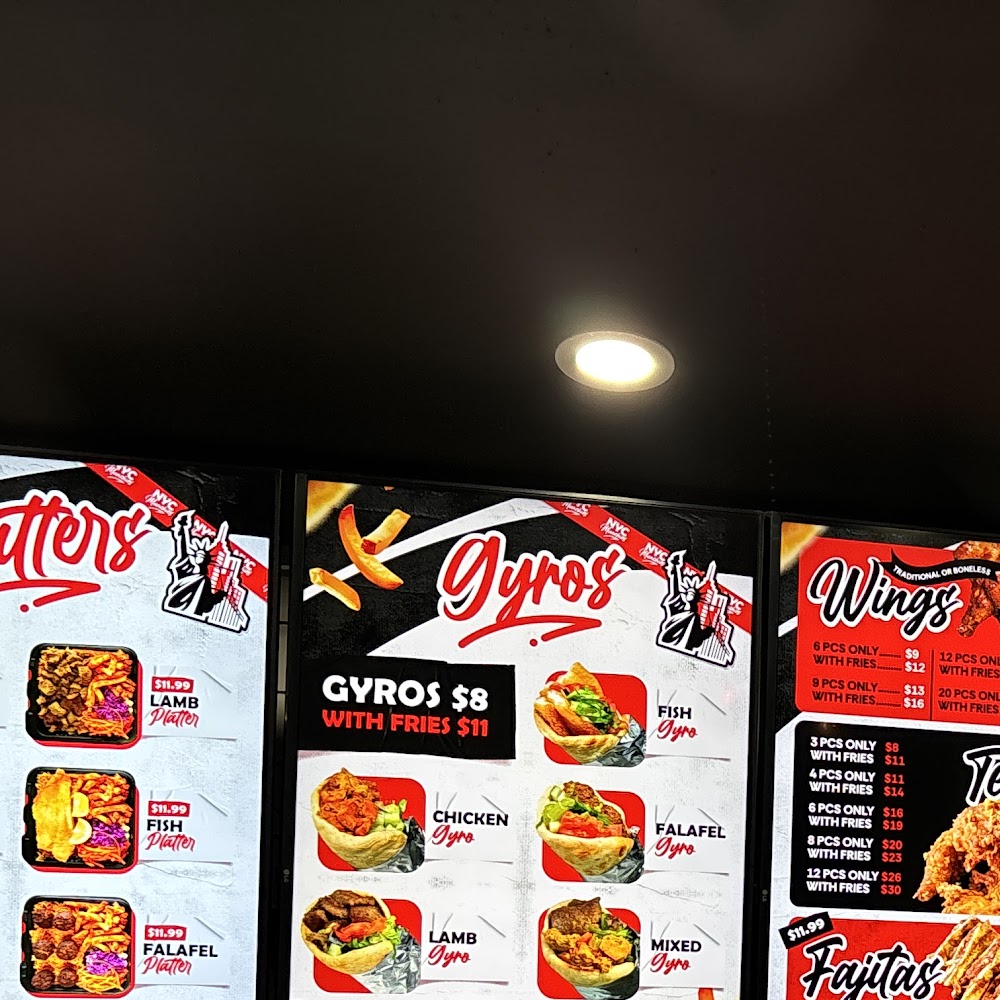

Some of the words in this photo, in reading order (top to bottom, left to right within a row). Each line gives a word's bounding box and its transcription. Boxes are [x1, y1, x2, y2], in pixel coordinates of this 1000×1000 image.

[893, 565, 942, 582] TRADITIONAL
[942, 568, 952, 577] OR
[953, 564, 992, 576] BONELESS
[809, 559, 960, 639] Wings
[813, 641, 820, 651] 6
[822, 642, 845, 654] PCS
[905, 648, 919, 660] $9
[155, 680, 190, 690] $11.99
[151, 695, 199, 709] LAMB
[322, 675, 441, 709] GYROS
[452, 684, 489, 713] $8
[149, 708, 199, 727] Platter
[658, 705, 692, 720] FISH
[322, 709, 384, 730] WITH
[390, 713, 451, 735] FRIES
[458, 717, 489, 737] $11
[147, 818, 183, 833] FISH
[433, 810, 509, 827] CHICKEN
[807, 868, 818, 879] 12
[821, 868, 845, 880] PCS
[848, 869, 879, 882] ONLY
[881, 871, 901, 883] $26
[786, 918, 826, 942] $11.99
[429, 931, 477, 946] LAMB
[651, 938, 702, 952] MIXED
[143, 943, 218, 958] FALAFEL
